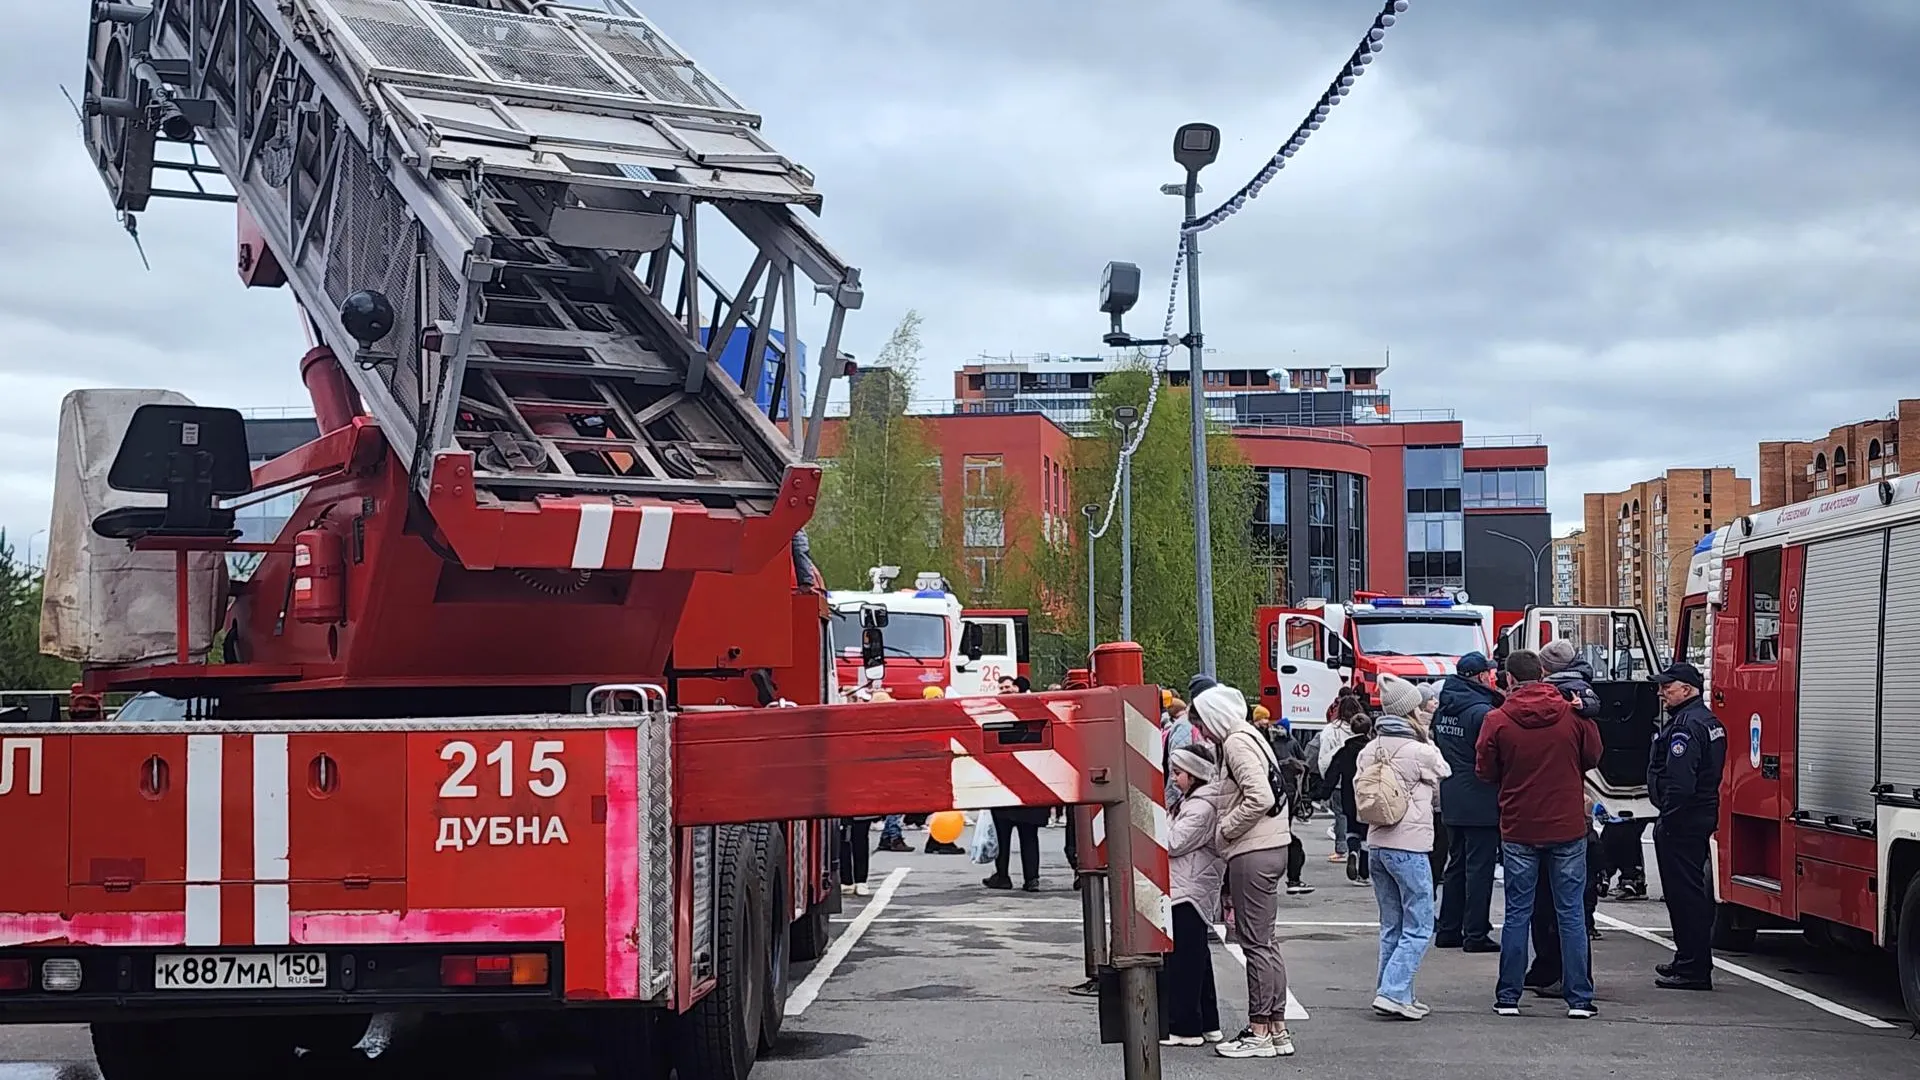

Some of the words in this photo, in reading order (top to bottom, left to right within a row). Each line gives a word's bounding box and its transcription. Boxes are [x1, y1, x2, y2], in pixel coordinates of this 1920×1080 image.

[982, 665, 1000, 681] 26
[1292, 683, 1311, 698] 49
[1440, 715, 1459, 726] МЧС
[1435, 724, 1464, 737] РОССИИ
[438, 740, 567, 798] 215
[435, 815, 569, 852] ДУБНА
[279, 954, 320, 976] 150
[288, 976, 309, 984] RUS
